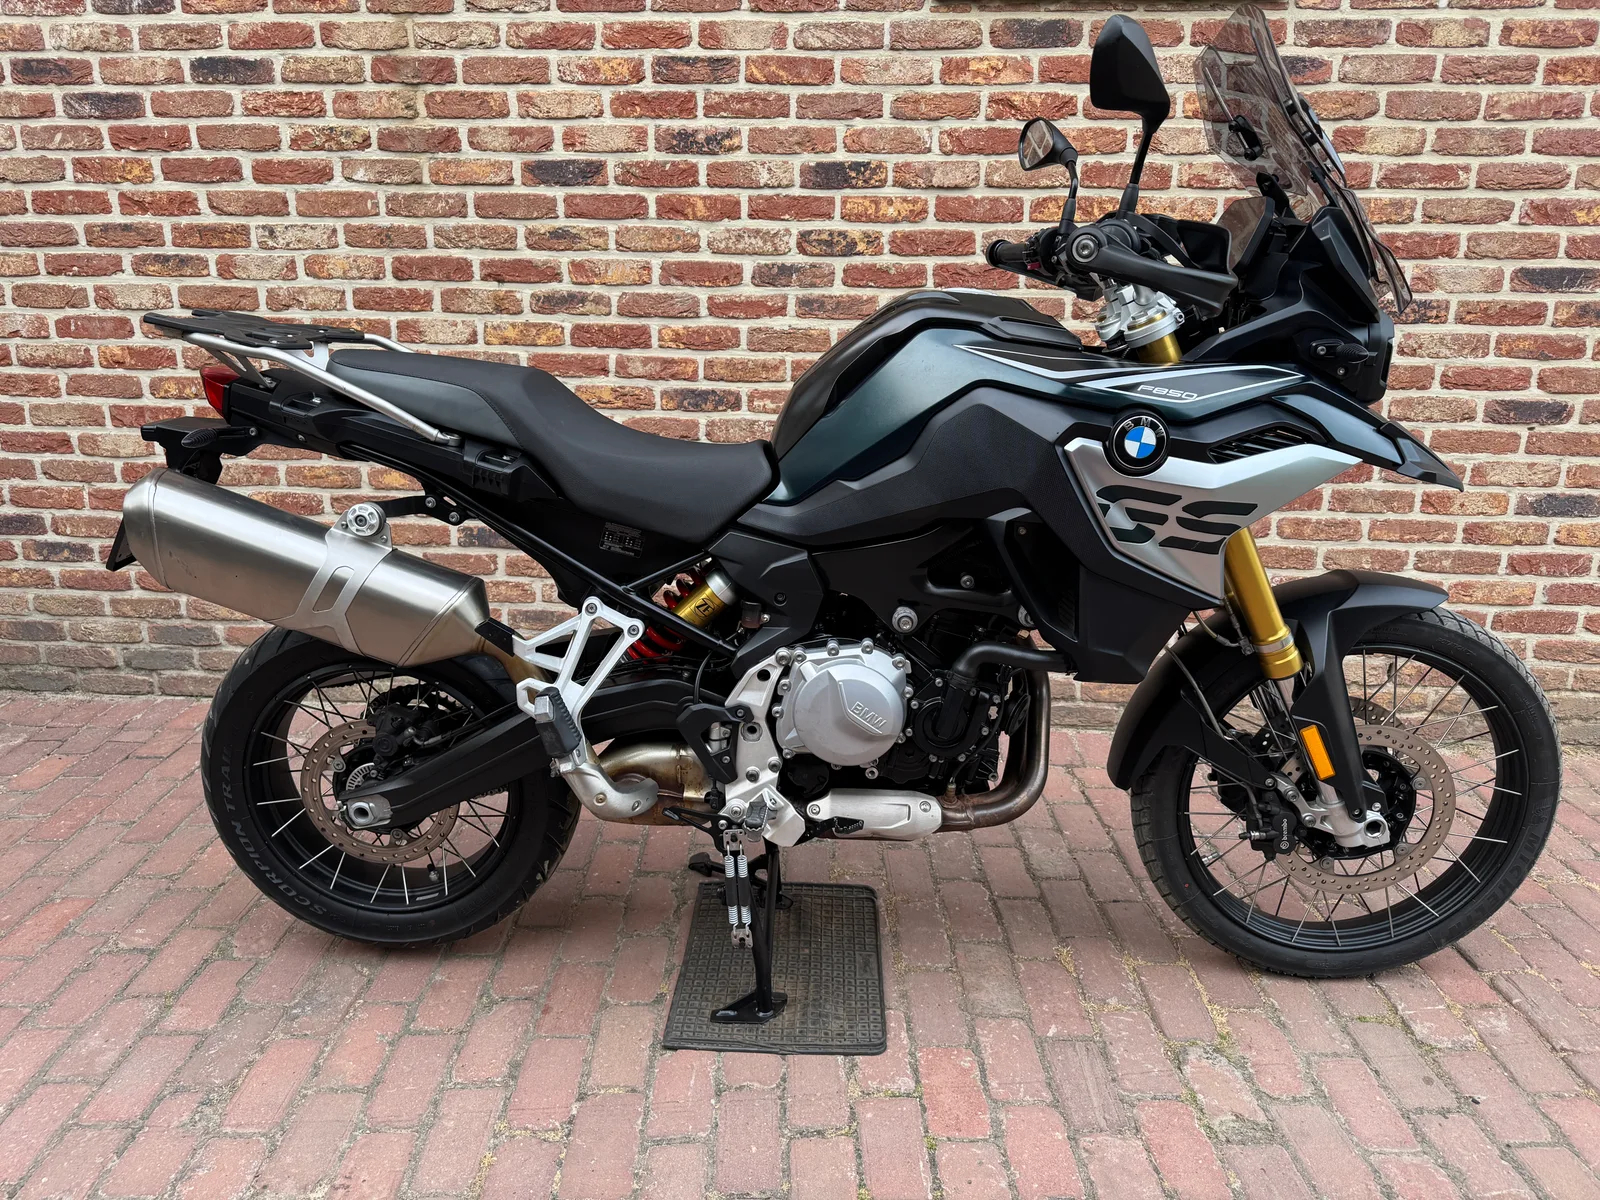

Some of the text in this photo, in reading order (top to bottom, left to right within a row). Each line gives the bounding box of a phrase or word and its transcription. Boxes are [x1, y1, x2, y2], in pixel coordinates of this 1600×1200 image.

[1137, 384, 1198, 400] F850
[1123, 417, 1165, 438] BMW
[696, 598, 715, 617] ZF
[850, 701, 887, 728] BMW
[220, 745, 327, 915] SCORPION TRAIL
[1449, 833, 1541, 936] MICHELIN
